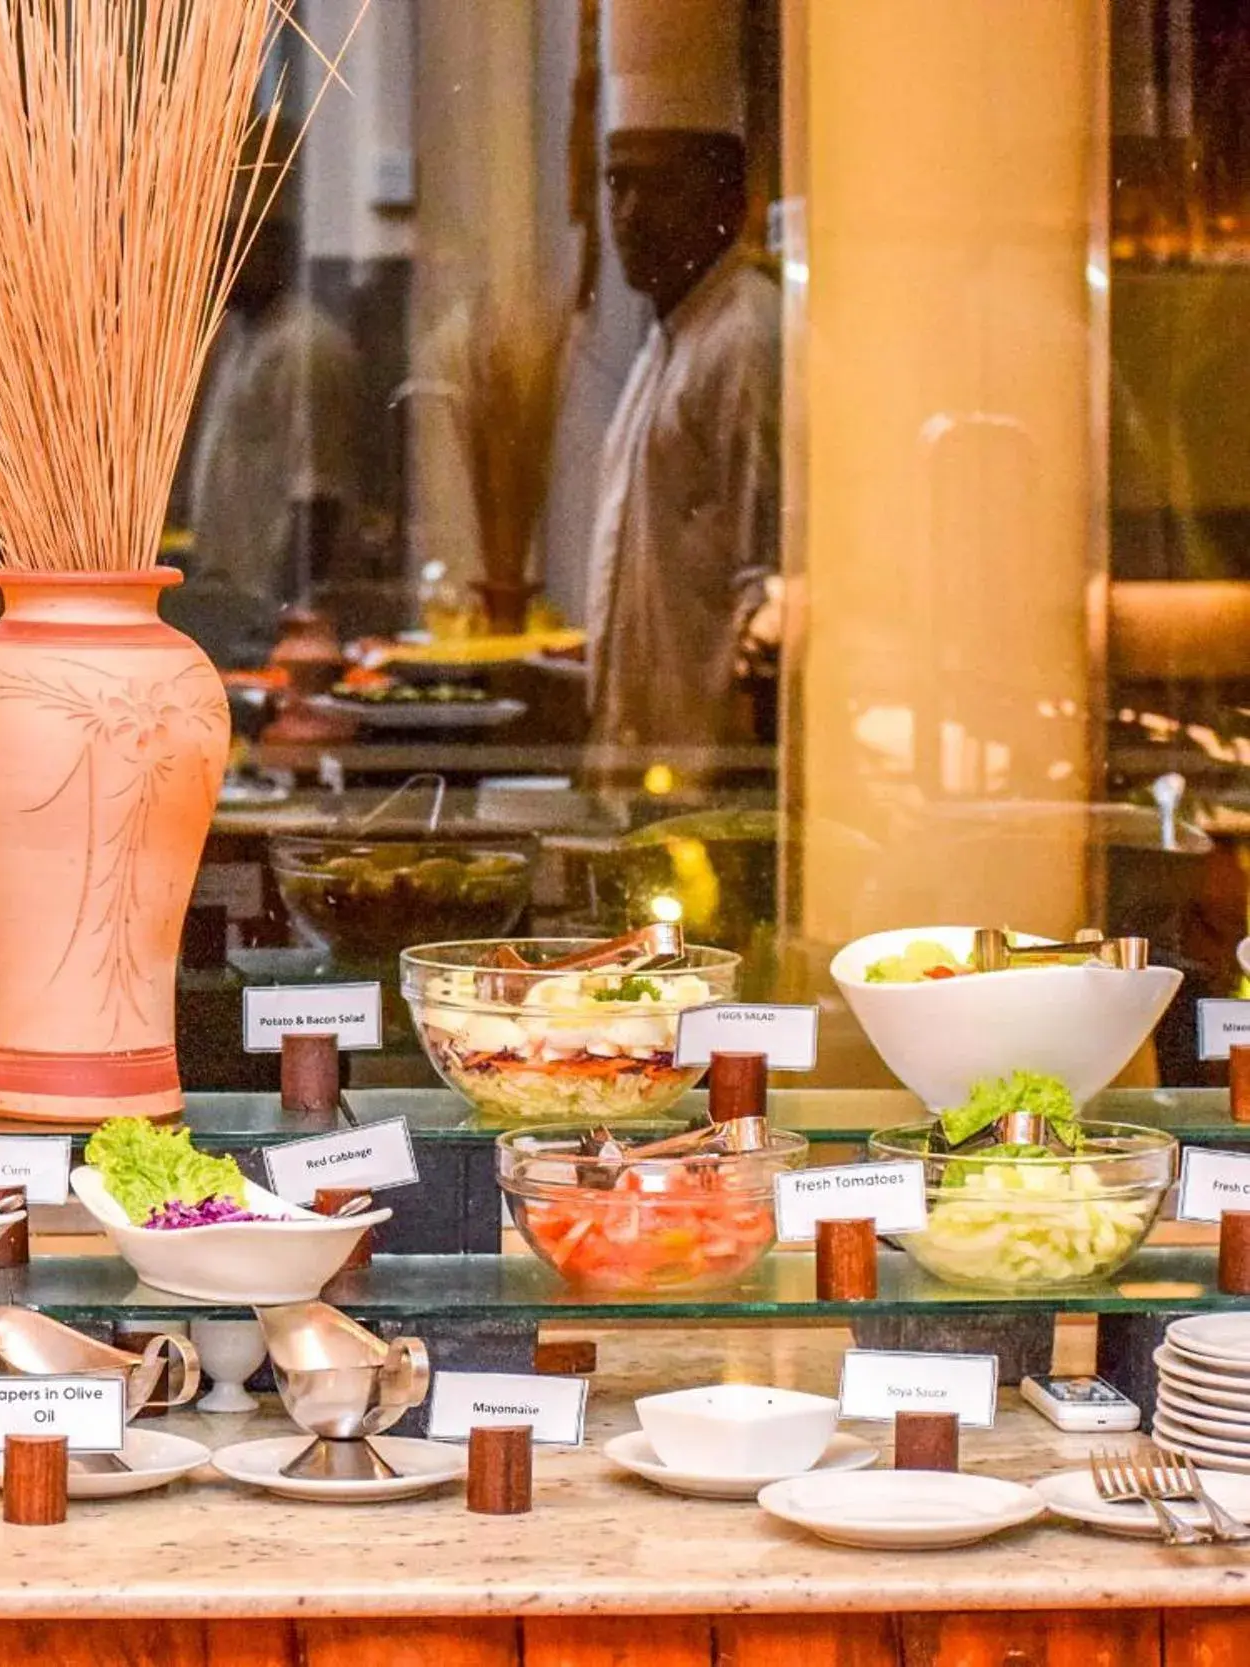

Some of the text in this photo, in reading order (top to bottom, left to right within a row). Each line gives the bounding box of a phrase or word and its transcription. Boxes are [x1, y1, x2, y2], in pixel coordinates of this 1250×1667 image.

[260, 1014, 366, 1026] Potato & Bacon Salad
[744, 1012, 776, 1021] SALAD
[306, 1147, 373, 1169] Red Cabbage
[1, 1164, 31, 1175] Corn
[795, 1173, 904, 1192] Fresh Tomatoes
[1213, 1180, 1241, 1192] Fresh
[45, 1387, 58, 1399] in
[63, 1387, 103, 1399] Olive
[886, 1386, 948, 1398] Soya Sauce
[472, 1402, 540, 1416] Mayonnaise
[33, 1409, 55, 1422] Oil
